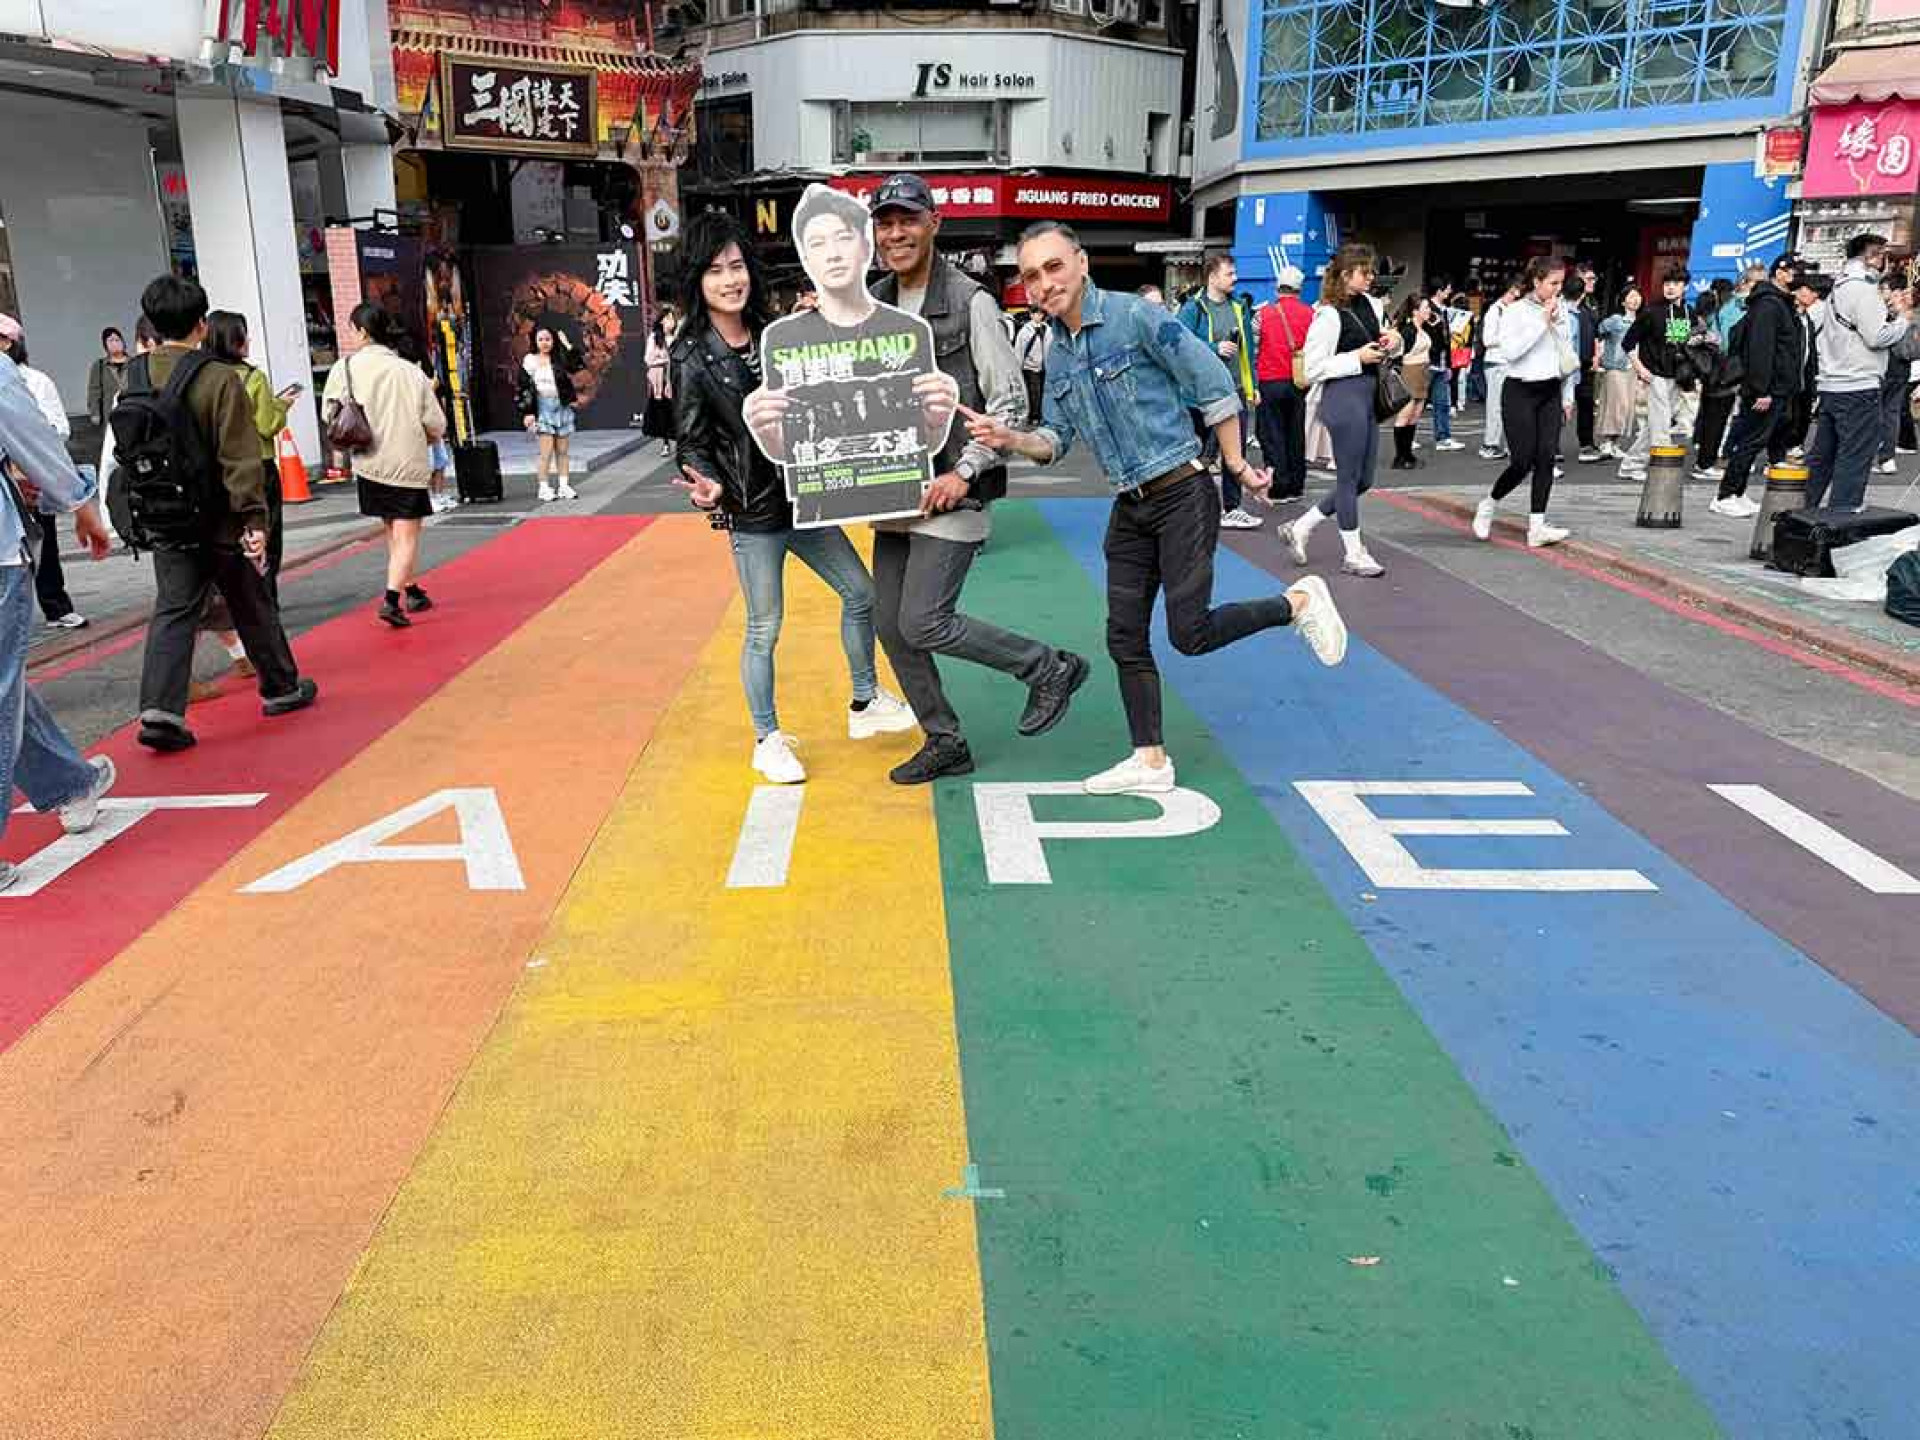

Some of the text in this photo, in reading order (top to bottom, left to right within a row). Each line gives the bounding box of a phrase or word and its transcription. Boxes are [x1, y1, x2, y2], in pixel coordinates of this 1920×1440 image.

[959, 72, 988, 87] Hair
[995, 72, 1035, 88] Salon
[1014, 189, 1160, 209] JIGUANG FRIED CHICKEN
[756, 199, 778, 234] N
